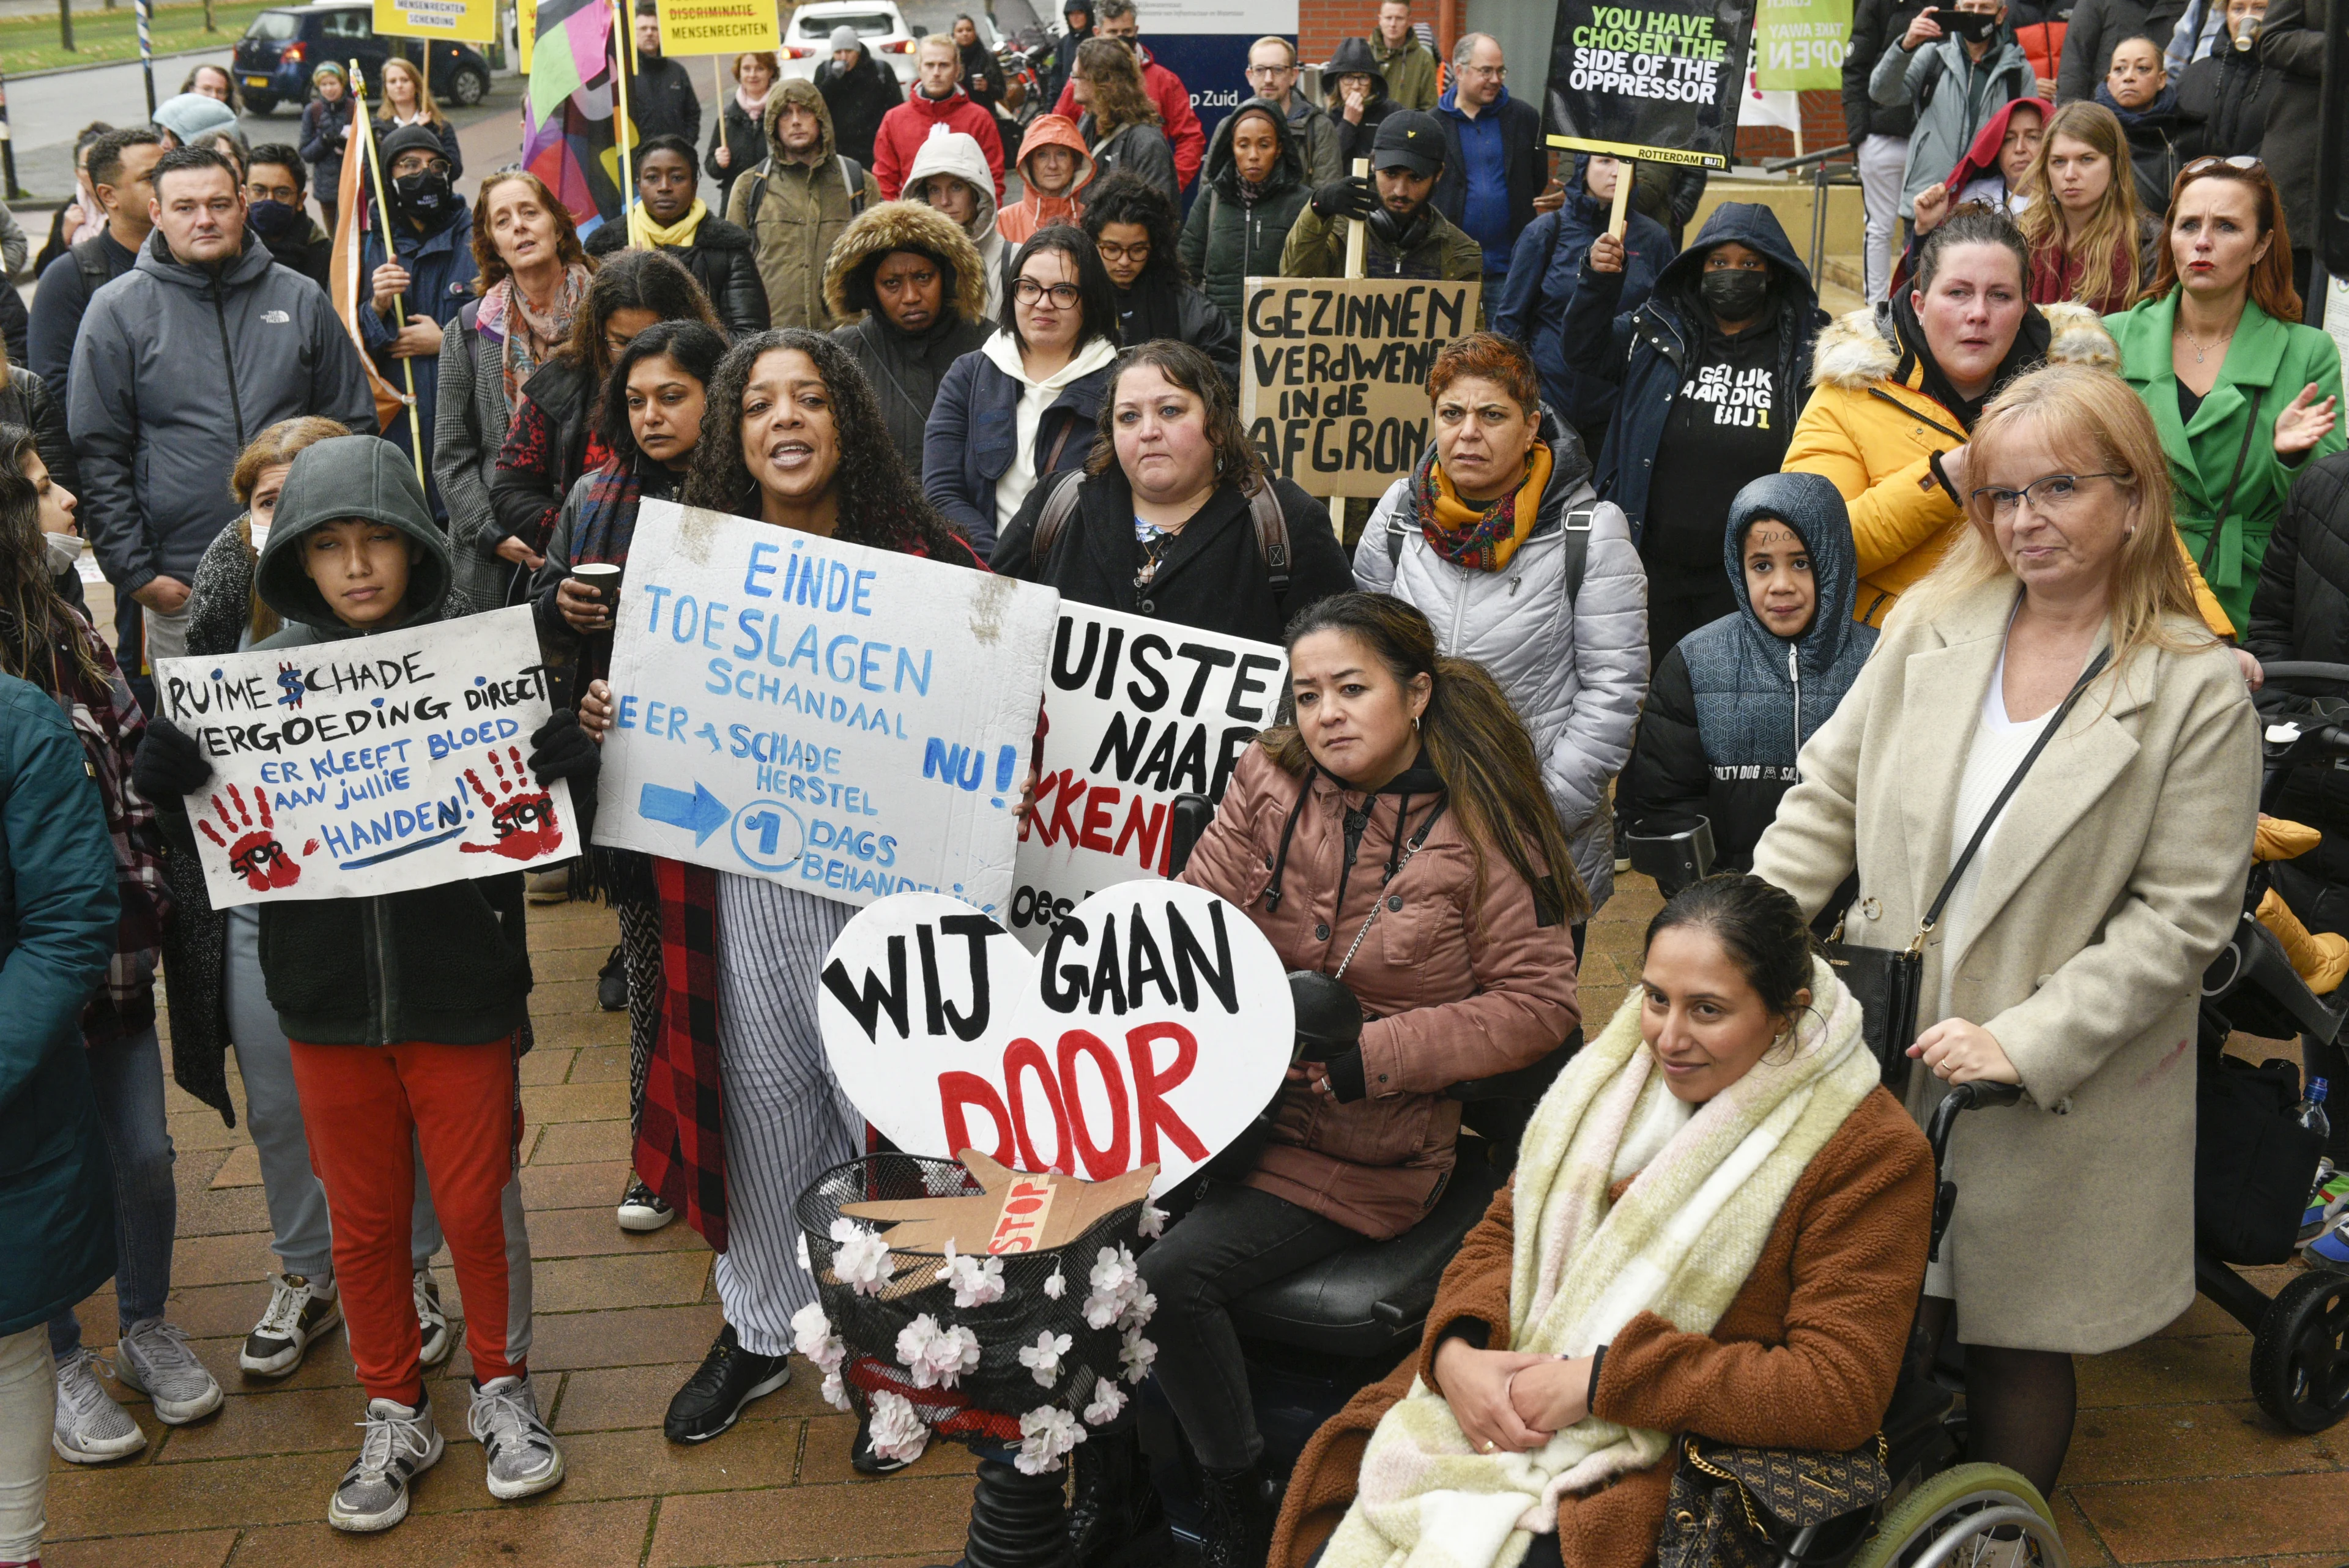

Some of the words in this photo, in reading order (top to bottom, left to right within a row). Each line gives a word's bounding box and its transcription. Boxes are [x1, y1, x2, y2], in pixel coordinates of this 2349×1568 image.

[672, 23, 768, 39] MENSENRECHTEN
[1592, 6, 1642, 31] YOU
[1646, 12, 1715, 39] HAVE
[1573, 26, 1672, 56] CHOSEN
[1678, 36, 1727, 62] THE
[1573, 47, 1630, 73] SIDE
[1633, 54, 1667, 76] OF
[1671, 57, 1720, 83] THE
[1203, 89, 1238, 106] Zuid
[1569, 69, 1716, 105] OPPRESSOR
[1638, 149, 1699, 165] ROTTERDAM
[1704, 157, 1722, 166] BIJ1
[1248, 286, 1465, 339] GEZINNEN
[1714, 404, 1770, 429] BIJ1
[645, 584, 932, 697] TOESLAGEN
[705, 658, 908, 740] SCHANDAAL
[261, 762, 304, 784] ER
[428, 718, 519, 760] BLOED
[617, 695, 688, 745] EER
[729, 724, 841, 775] SCHADE
[757, 763, 878, 816] HERSTEL
[1739, 765, 1761, 779] DOG
[275, 782, 326, 811] AAN
[321, 776, 475, 858] HANDEN!
[492, 798, 554, 839] STOP
[230, 841, 283, 881] STOP
[808, 818, 897, 868] DAGS
[821, 914, 1008, 1044] WIJ
[1040, 899, 1239, 1016] GAAN
[937, 1021, 1211, 1182] DOOR
[987, 1182, 1048, 1255] STOP
